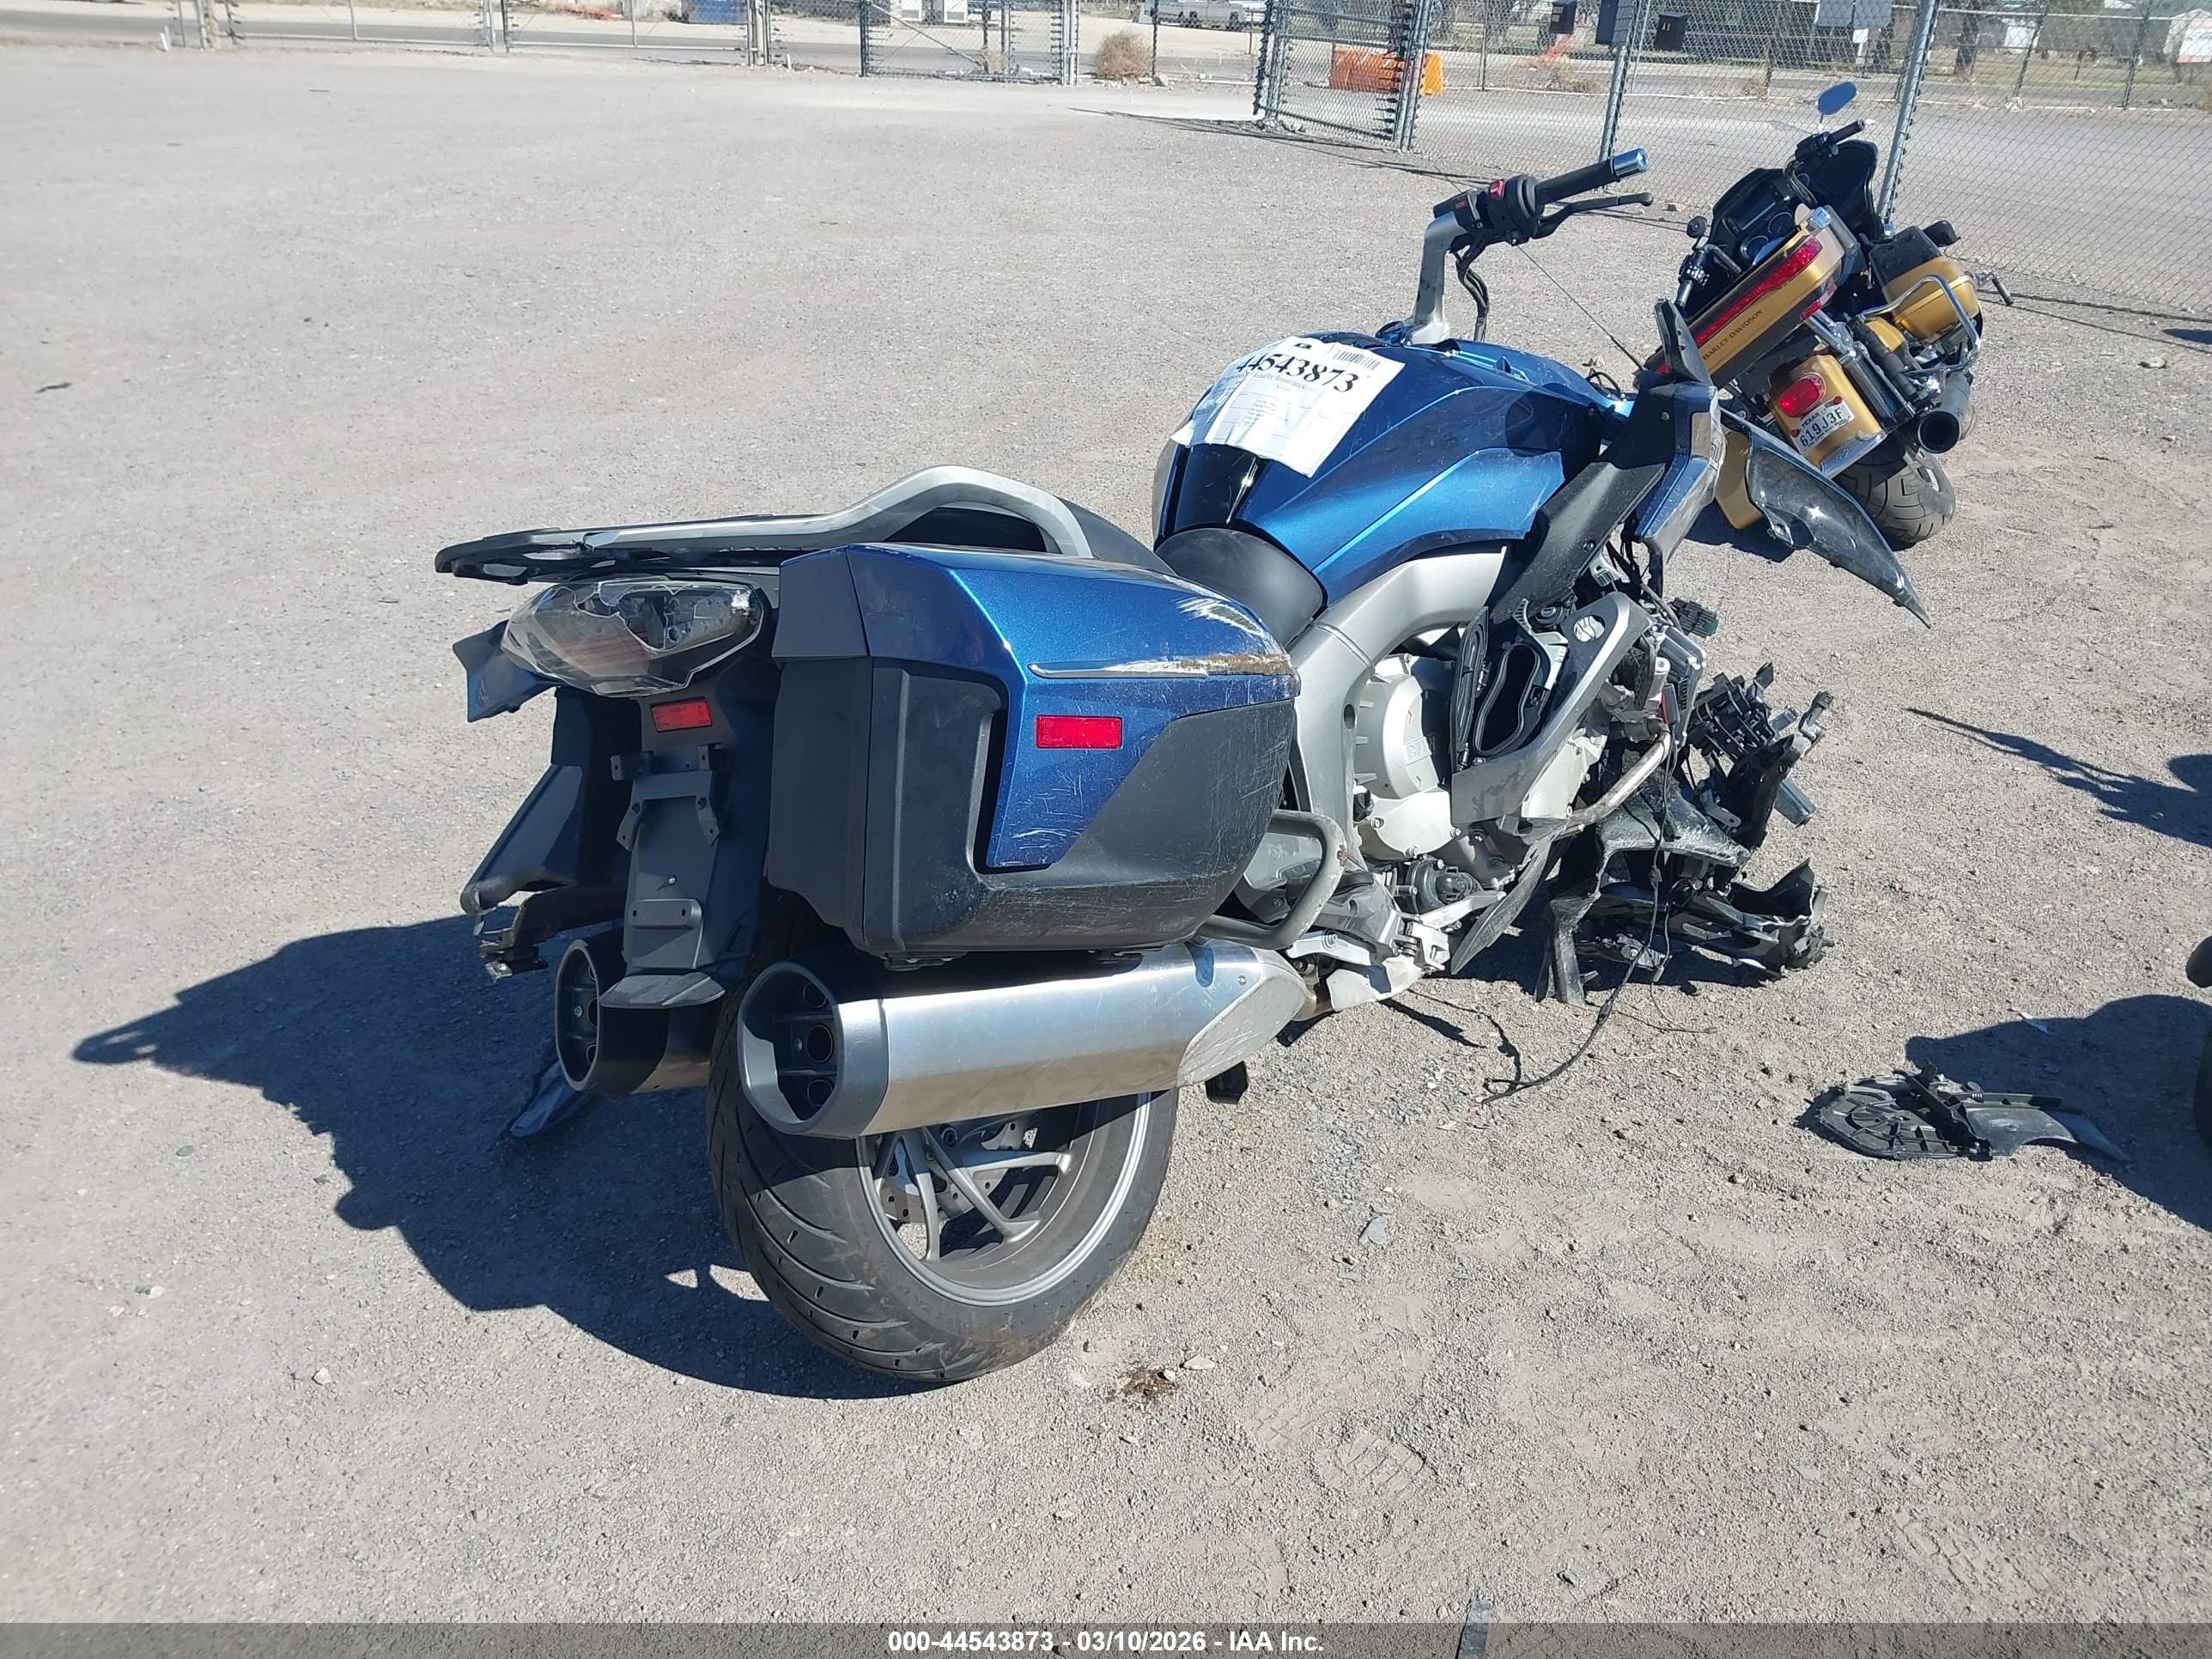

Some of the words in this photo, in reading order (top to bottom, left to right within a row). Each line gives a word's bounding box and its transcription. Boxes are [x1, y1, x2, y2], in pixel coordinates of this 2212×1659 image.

[1236, 352, 1359, 392] 44543873
[1799, 406, 1843, 447] 619J3F
[1800, 412, 1820, 428] TEXAS
